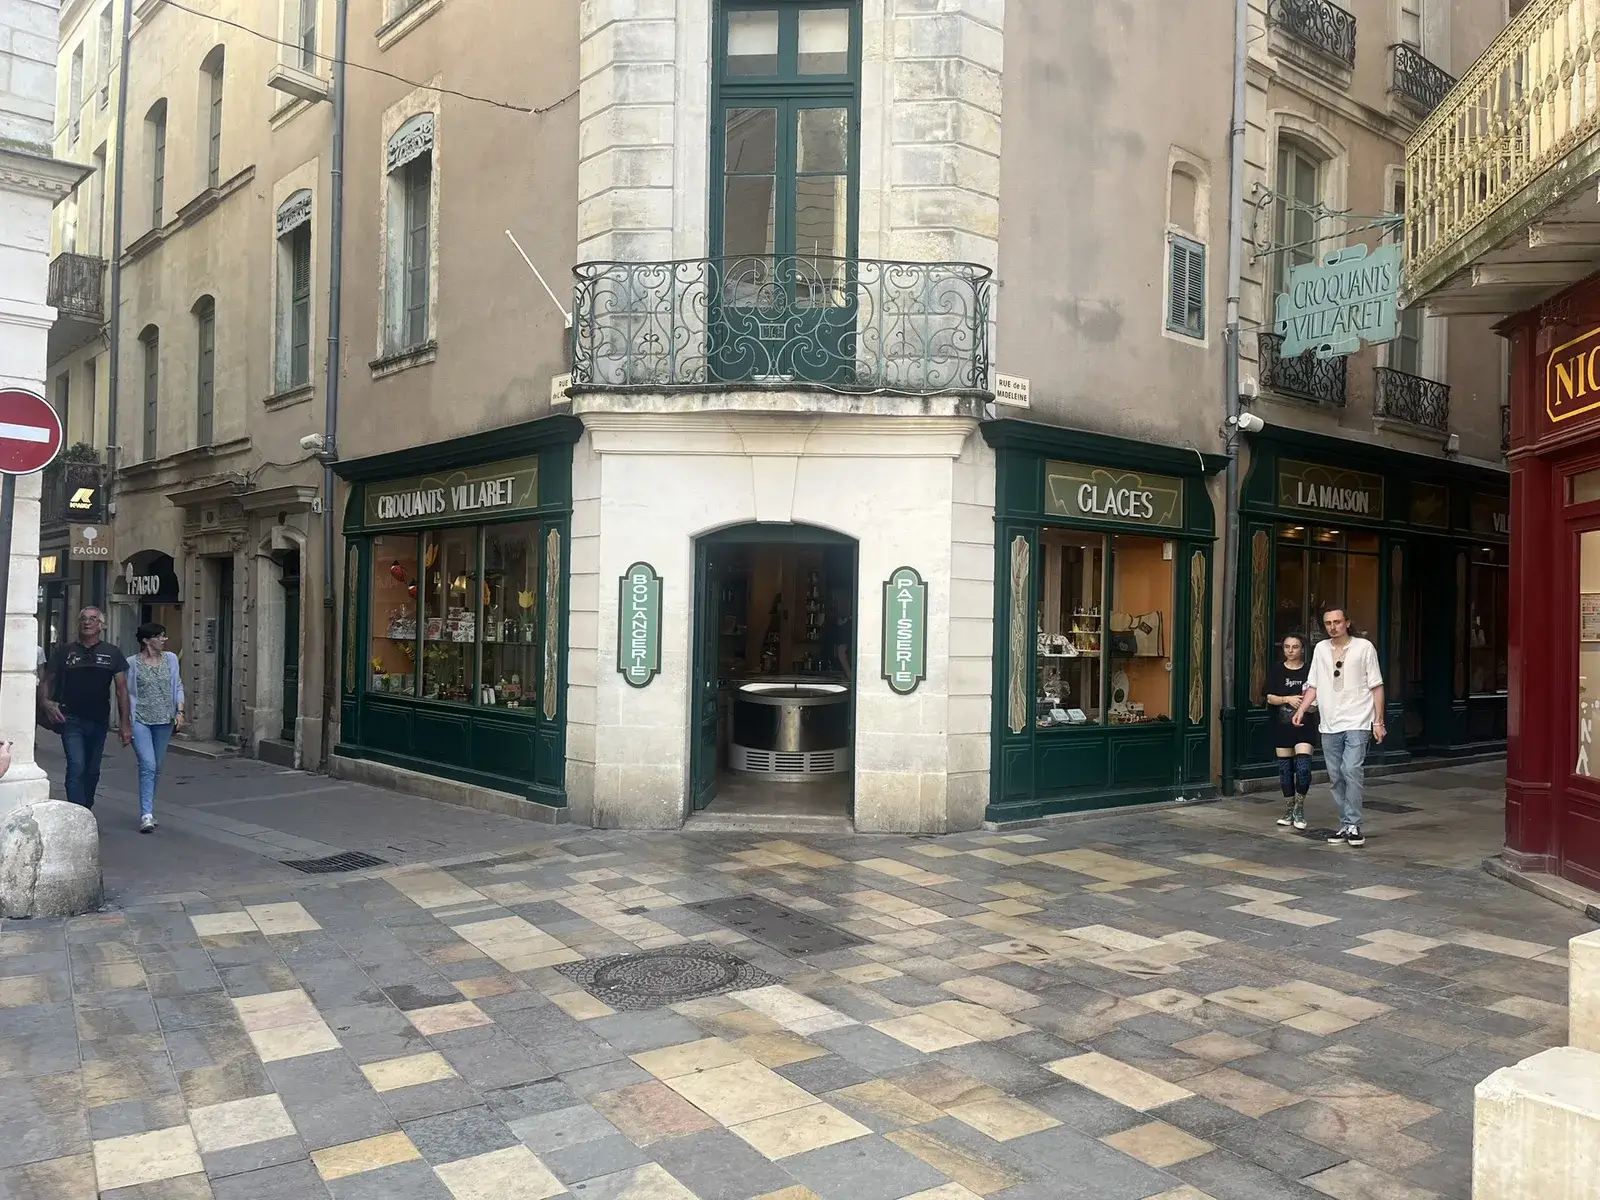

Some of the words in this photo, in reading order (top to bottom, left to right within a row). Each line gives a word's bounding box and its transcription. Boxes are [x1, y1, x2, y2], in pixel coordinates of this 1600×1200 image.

[1293, 262, 1392, 310] CROQUANTS
[1292, 299, 1389, 341] VILLARET
[997, 390, 1027, 402] MADELEINE
[999, 379, 1011, 388] RUE
[1013, 382, 1020, 390] de
[377, 488, 446, 519] CROQUANTS
[450, 477, 516, 512] VILLARET
[1077, 483, 1153, 519] GLACES
[1297, 481, 1317, 506] LA
[1319, 485, 1369, 513] MAISON
[73, 547, 108, 555] FAGUO
[131, 575, 160, 595] FAGUO
[631, 574, 648, 676] BOULANGERIE
[896, 578, 913, 682] PATISSERIE
